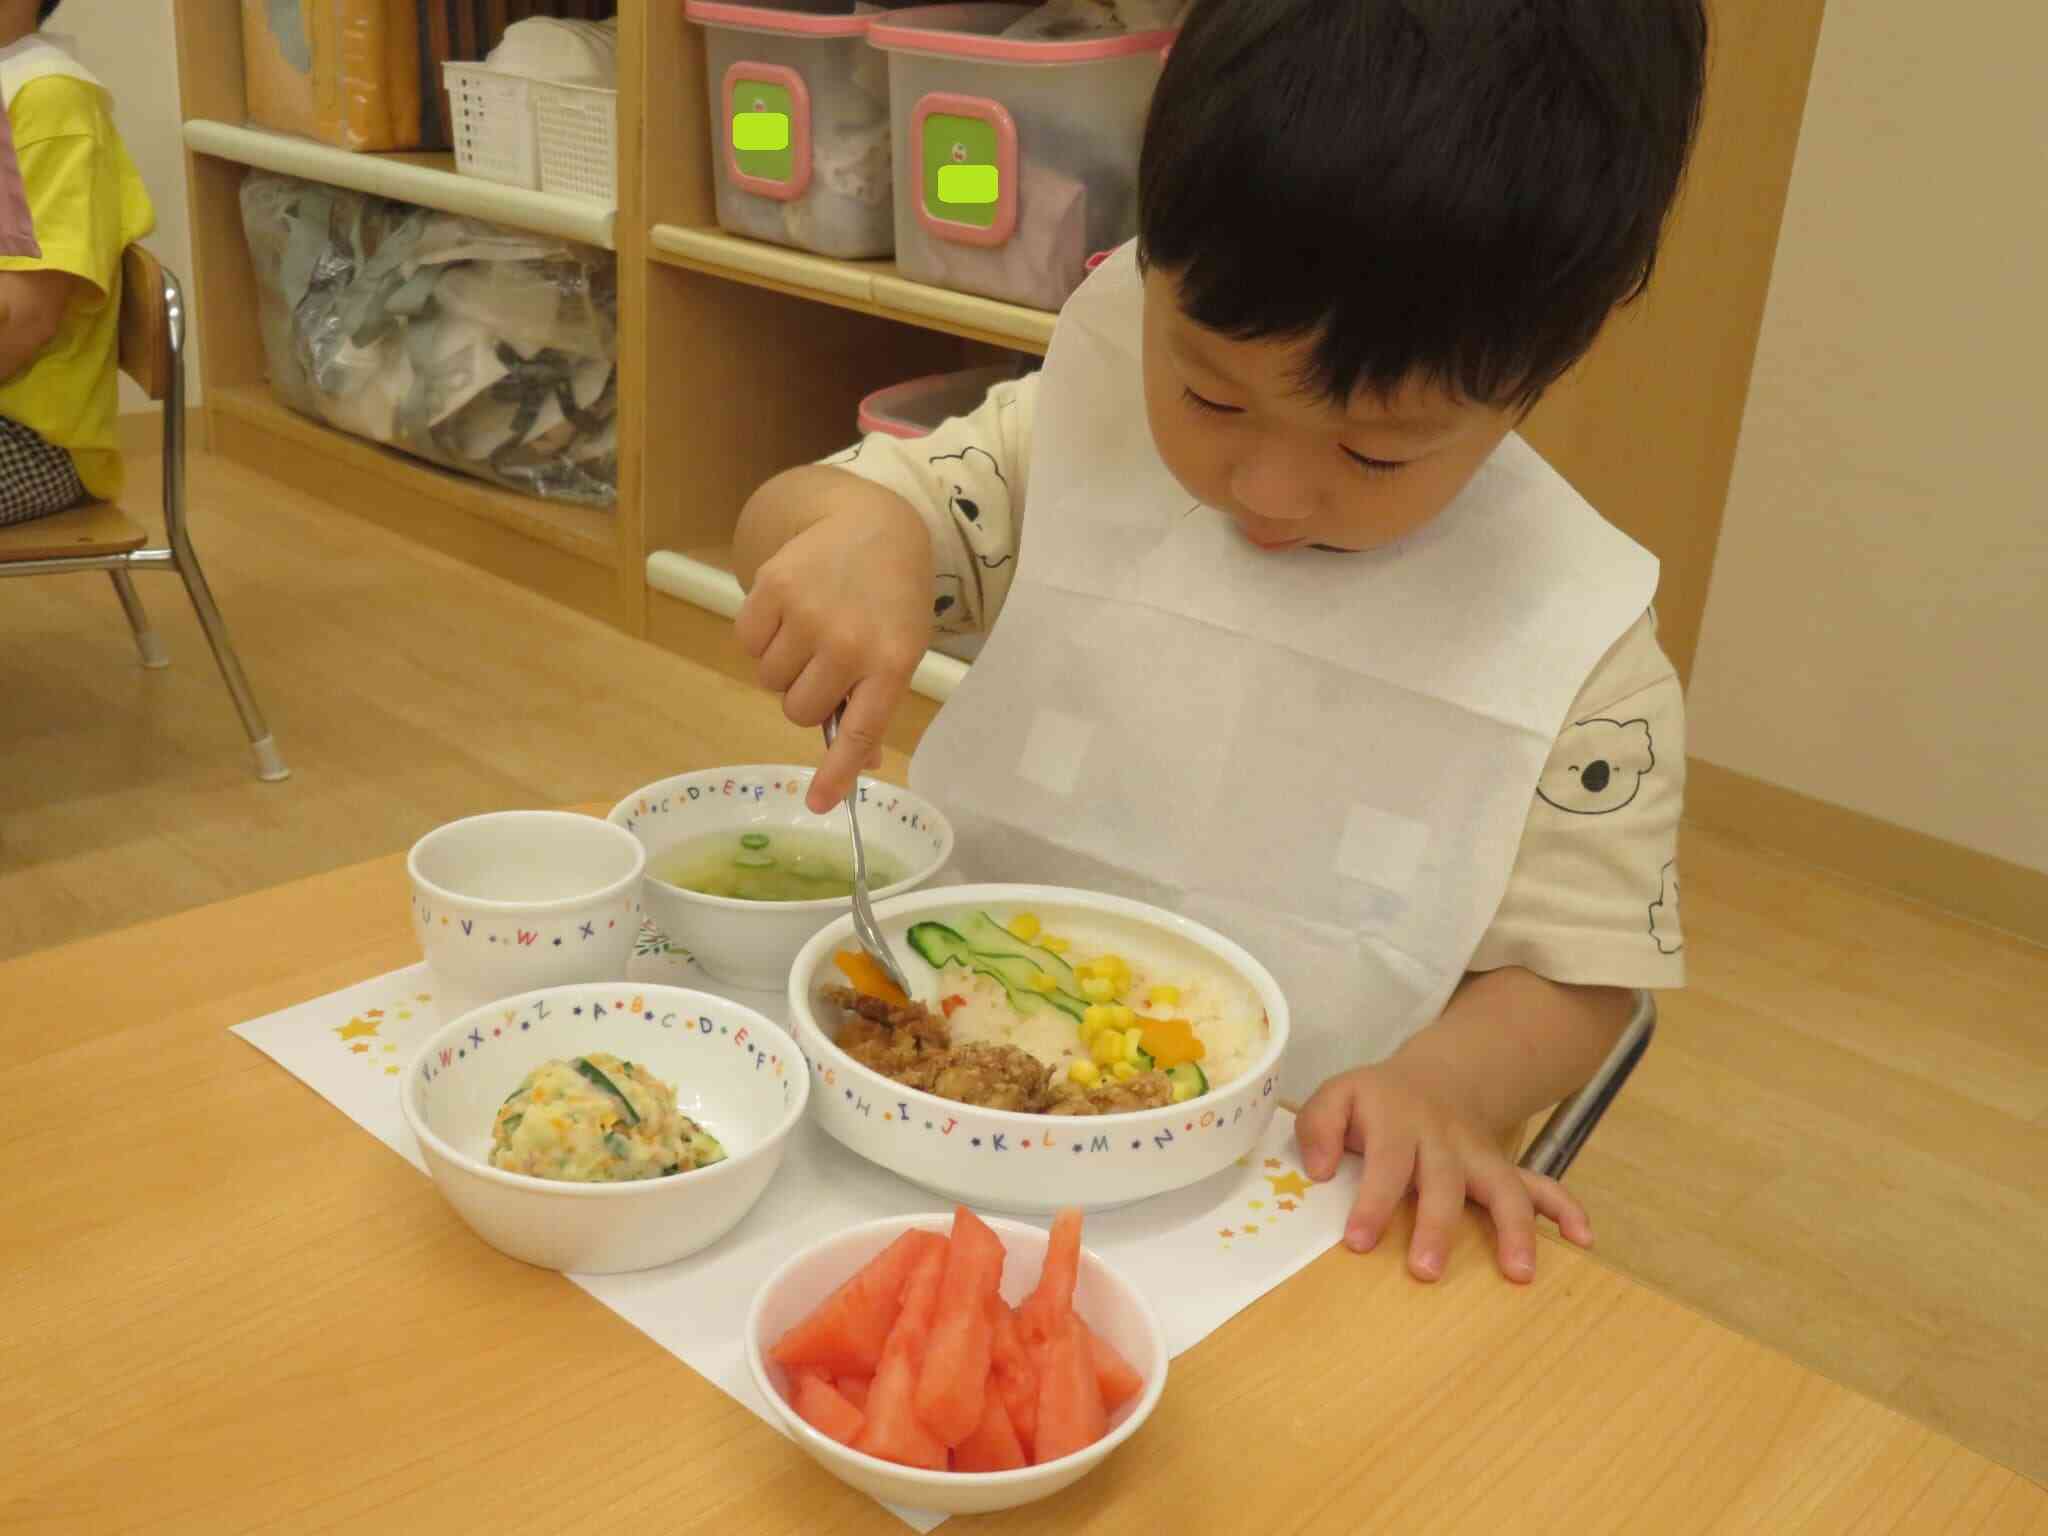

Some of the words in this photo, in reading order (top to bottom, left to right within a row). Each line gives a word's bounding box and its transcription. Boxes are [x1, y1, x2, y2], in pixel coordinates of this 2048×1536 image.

[661, 798, 669, 813] C
[687, 786, 700, 800] D
[722, 779, 736, 797] E
[753, 785, 765, 802] F
[461, 919, 473, 937] V
[517, 927, 539, 946] W
[579, 920, 595, 940] X
[438, 1047, 453, 1068] W
[467, 1027, 485, 1048] X
[532, 999, 551, 1020] Z
[594, 1003, 607, 1021] A
[661, 1013, 676, 1028] C
[699, 1016, 713, 1033] D
[734, 1026, 749, 1046] E
[756, 1050, 766, 1070] F
[856, 1096, 871, 1117] H
[898, 1103, 910, 1121] I
[942, 1118, 959, 1136] J
[993, 1133, 1008, 1152] K
[1042, 1128, 1056, 1148] L
[1091, 1135, 1109, 1152] M
[1154, 1128, 1174, 1149] N
[1200, 1111, 1215, 1128] O
